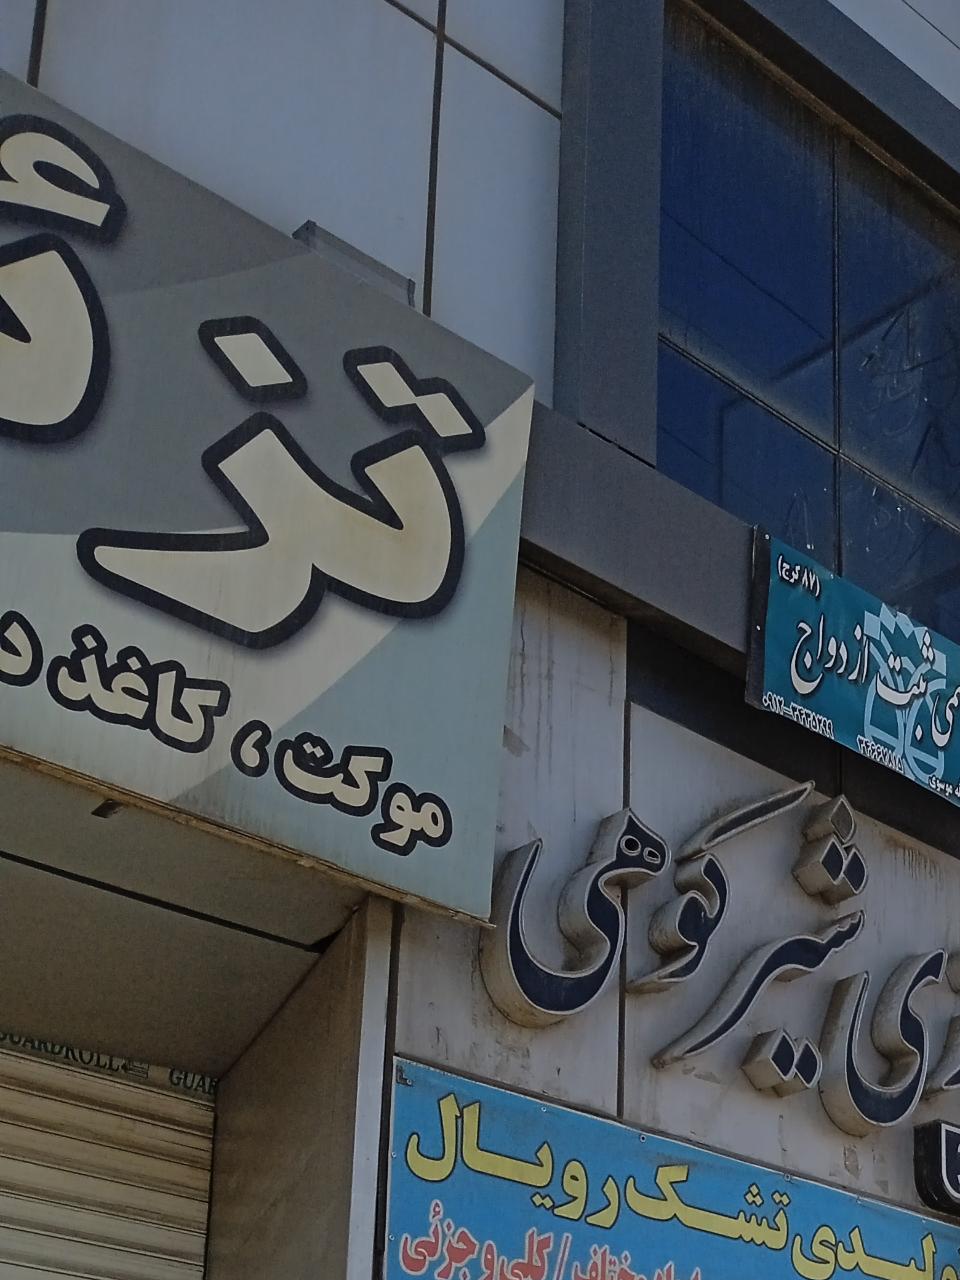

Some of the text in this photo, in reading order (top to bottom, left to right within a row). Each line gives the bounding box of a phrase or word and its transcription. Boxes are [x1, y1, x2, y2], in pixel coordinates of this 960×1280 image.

[46, 624, 230, 753] کاغذ
[790, 614, 869, 695] ازدواج
[876, 631, 934, 739] ثبت
[406, 1092, 619, 1230] رویال
[625, 1163, 790, 1251] تشک
